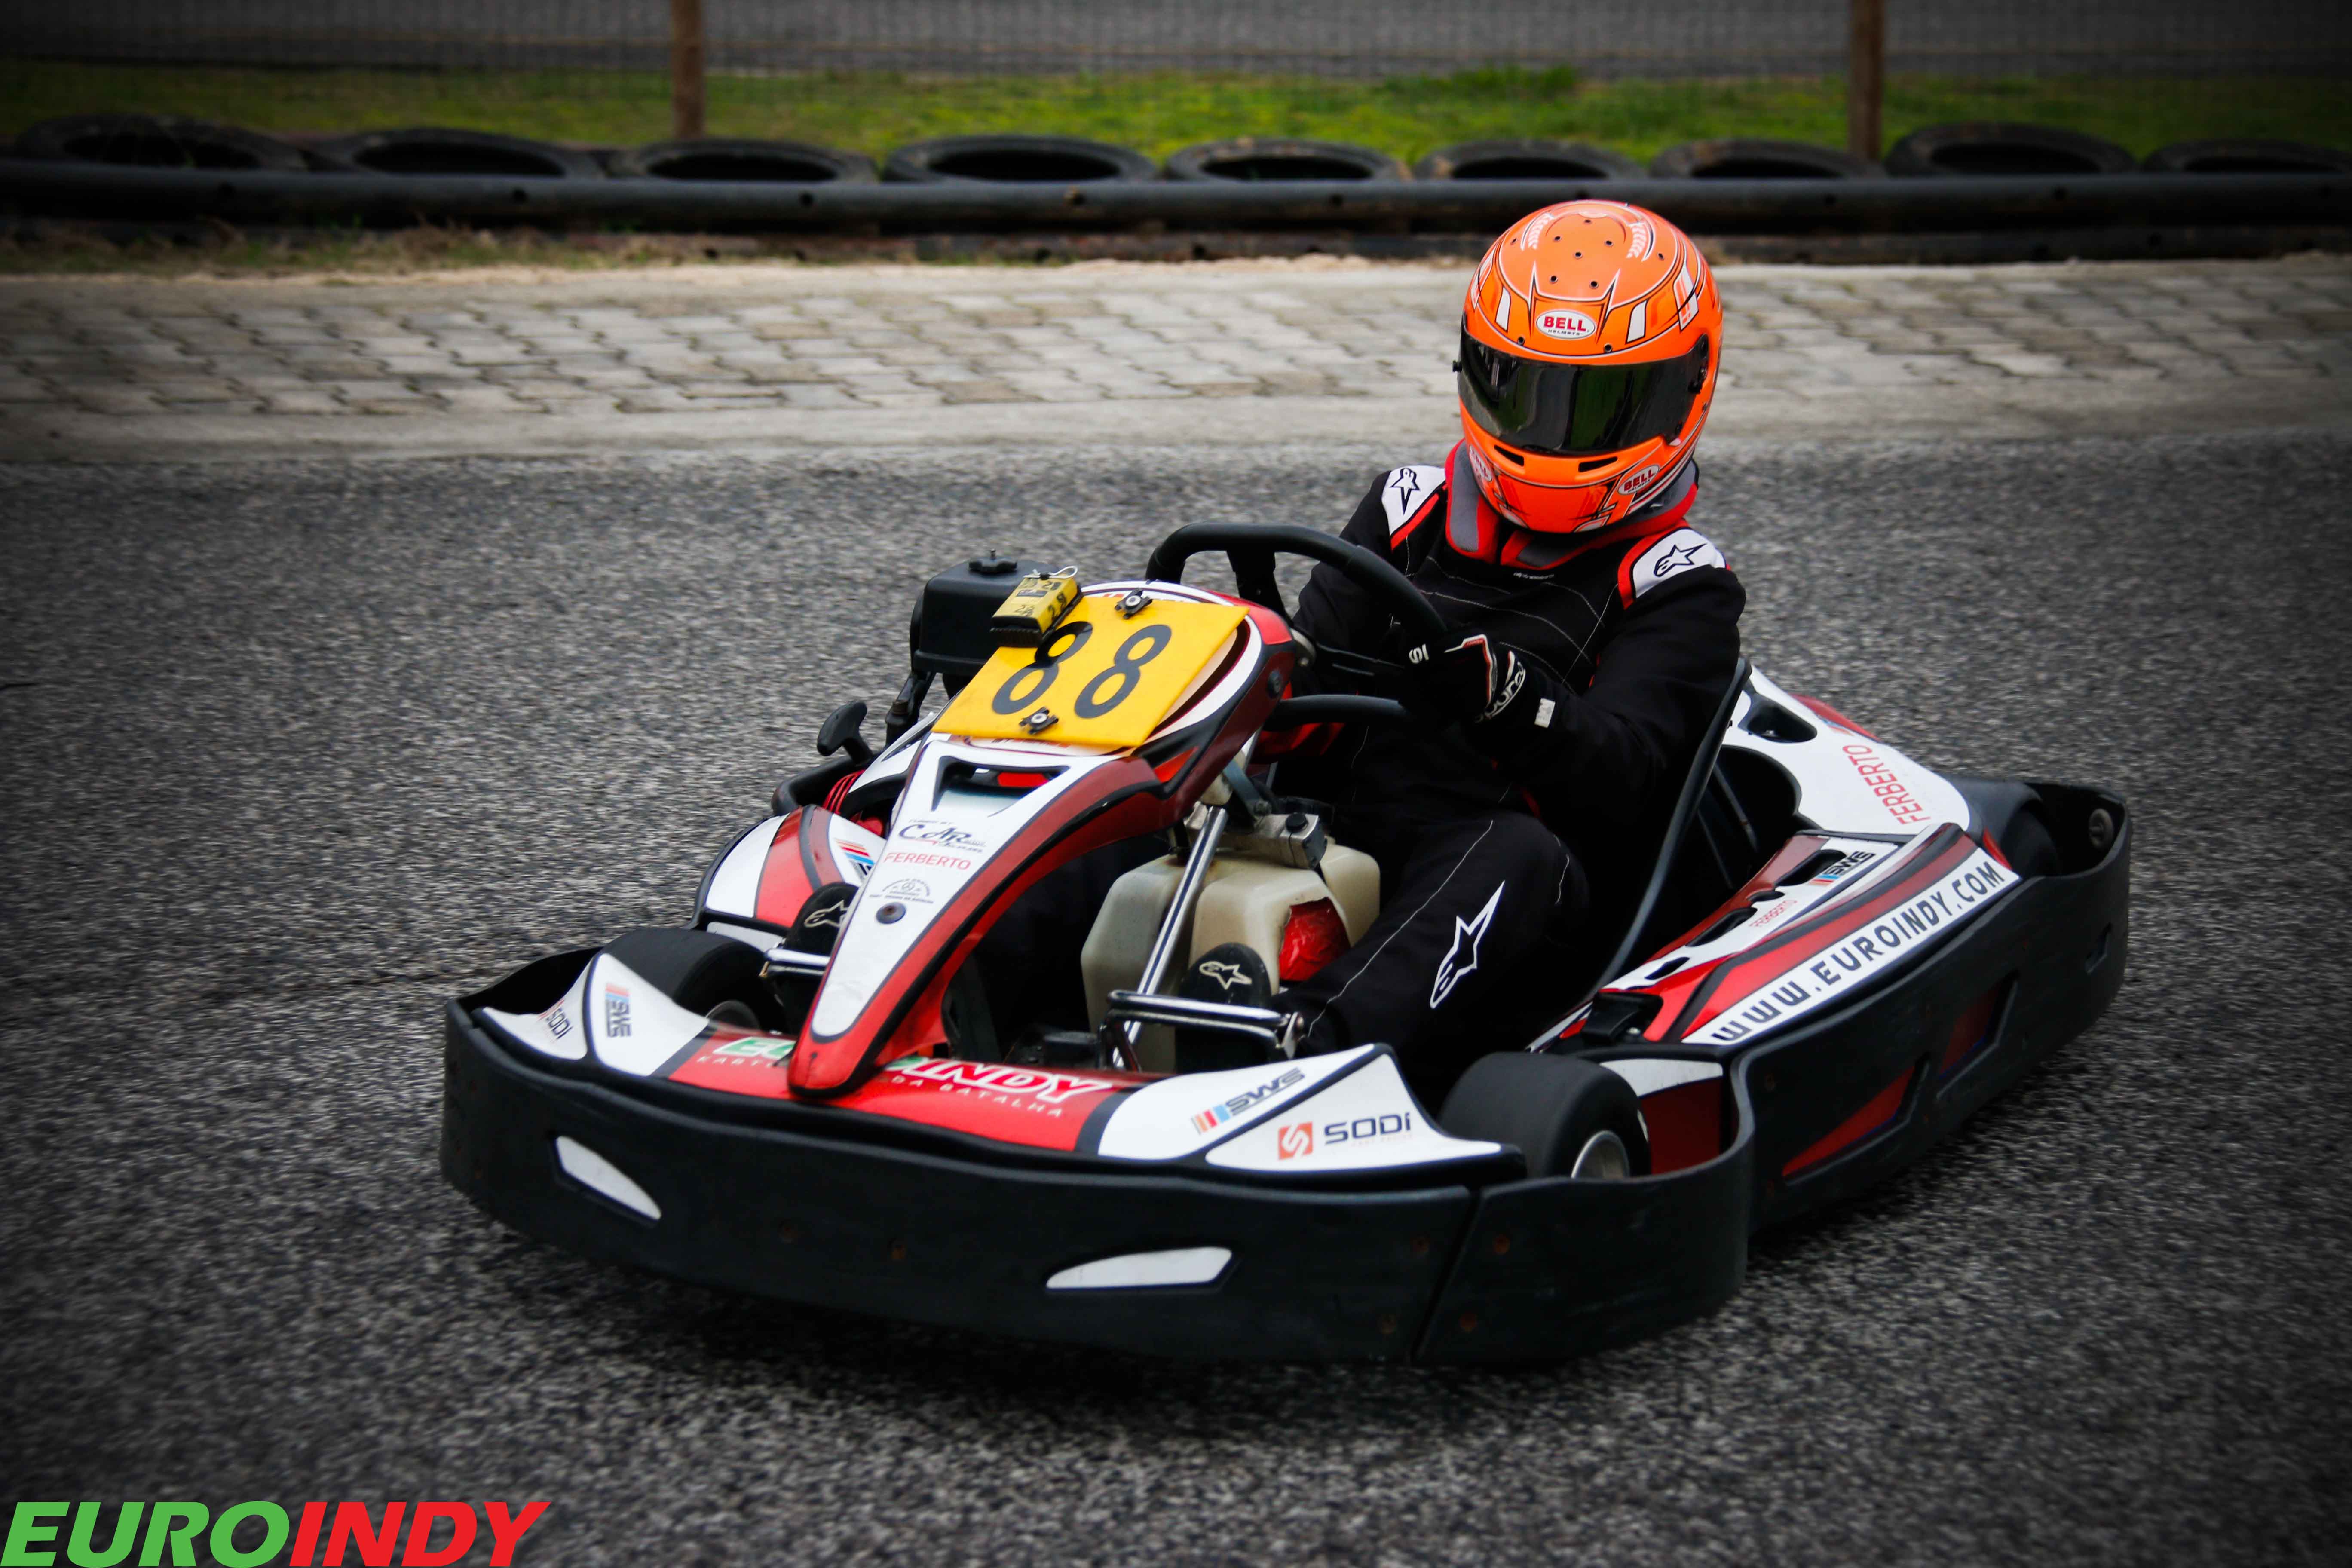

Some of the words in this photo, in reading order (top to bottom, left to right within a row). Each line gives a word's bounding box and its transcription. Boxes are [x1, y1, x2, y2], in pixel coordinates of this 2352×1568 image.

[1544, 316, 1587, 332] BELL
[1624, 469, 1654, 491] BELL
[992, 621, 1172, 719] 88
[1843, 744, 1930, 825] FERBERTO
[883, 852, 971, 870] FERBERTO
[1711, 861, 2004, 1041] WWW.EUROINDY.COM
[940, 1083, 1062, 1117] BATALHA
[1225, 1067, 1305, 1116] SWS
